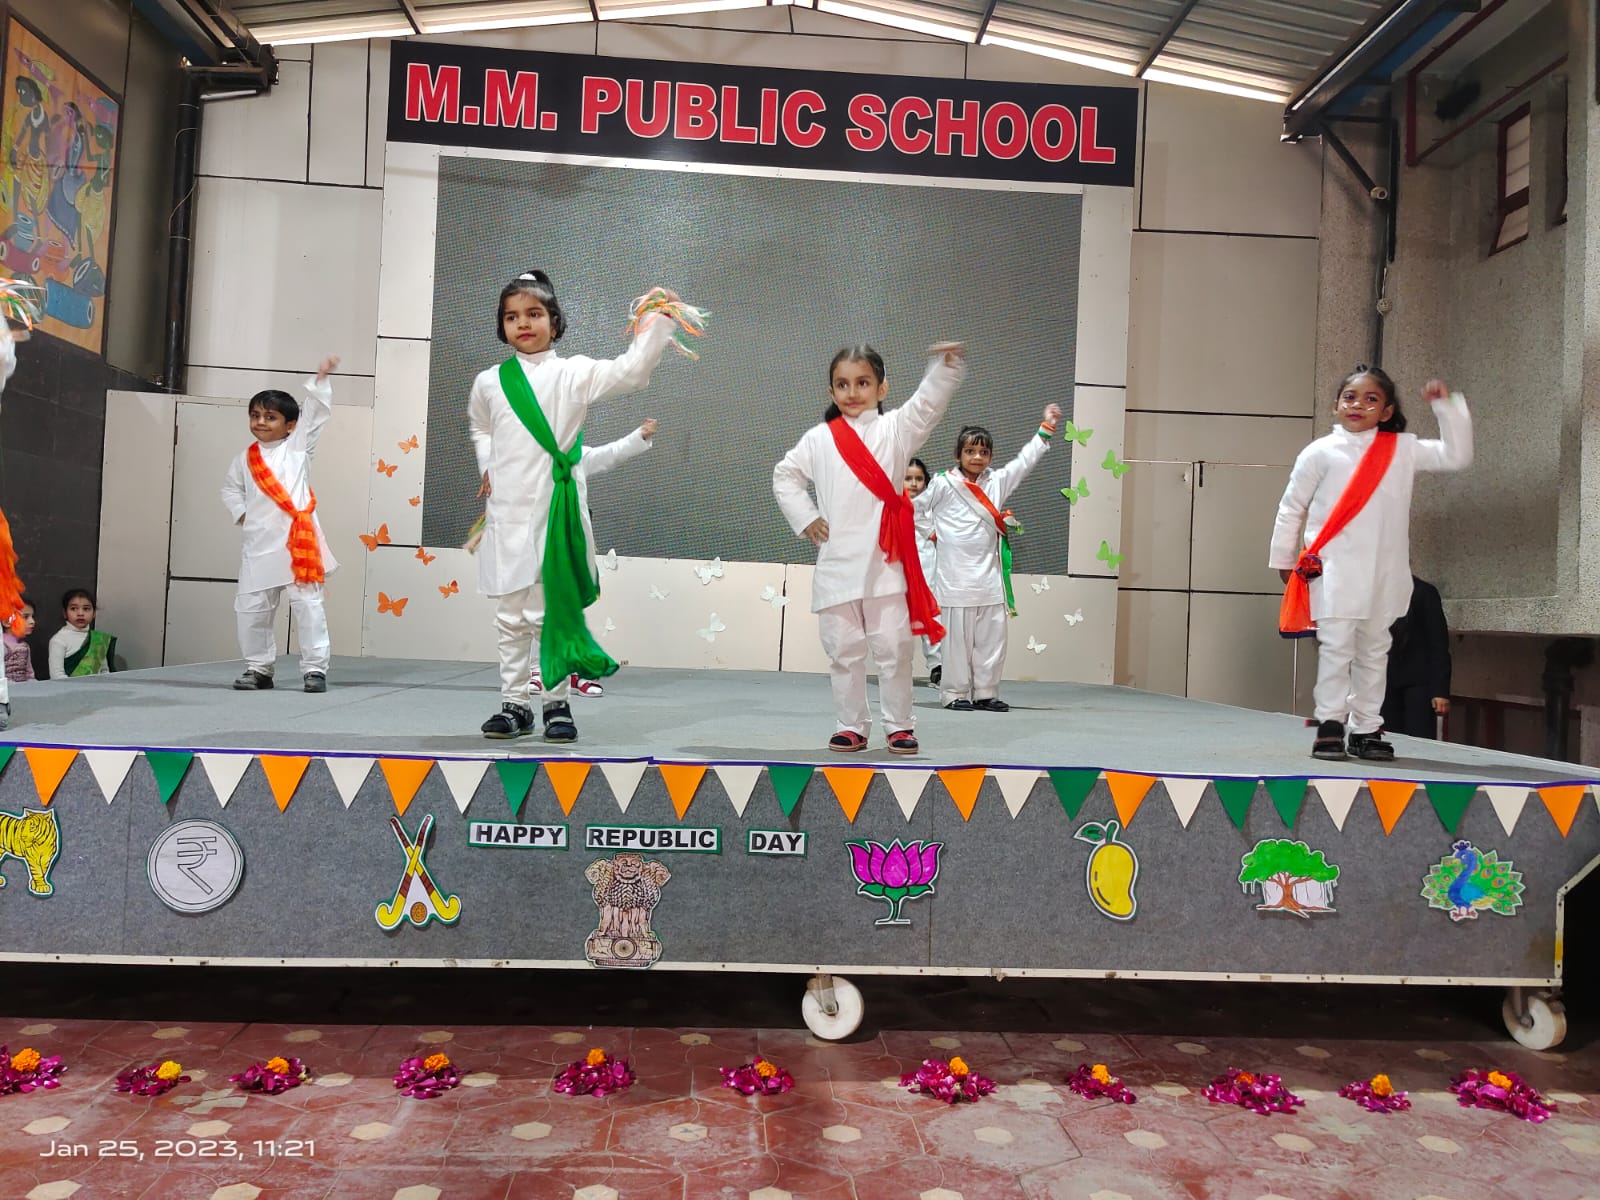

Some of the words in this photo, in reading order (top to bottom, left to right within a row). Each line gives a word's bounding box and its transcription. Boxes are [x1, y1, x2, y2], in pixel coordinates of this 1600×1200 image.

[404, 62, 558, 131] M.M.
[580, 75, 827, 149] PUBLIC
[845, 93, 1118, 165] SCHOOL
[475, 824, 563, 846] HAPPY
[588, 827, 717, 849] REPUBLIC
[750, 831, 802, 853] DAY
